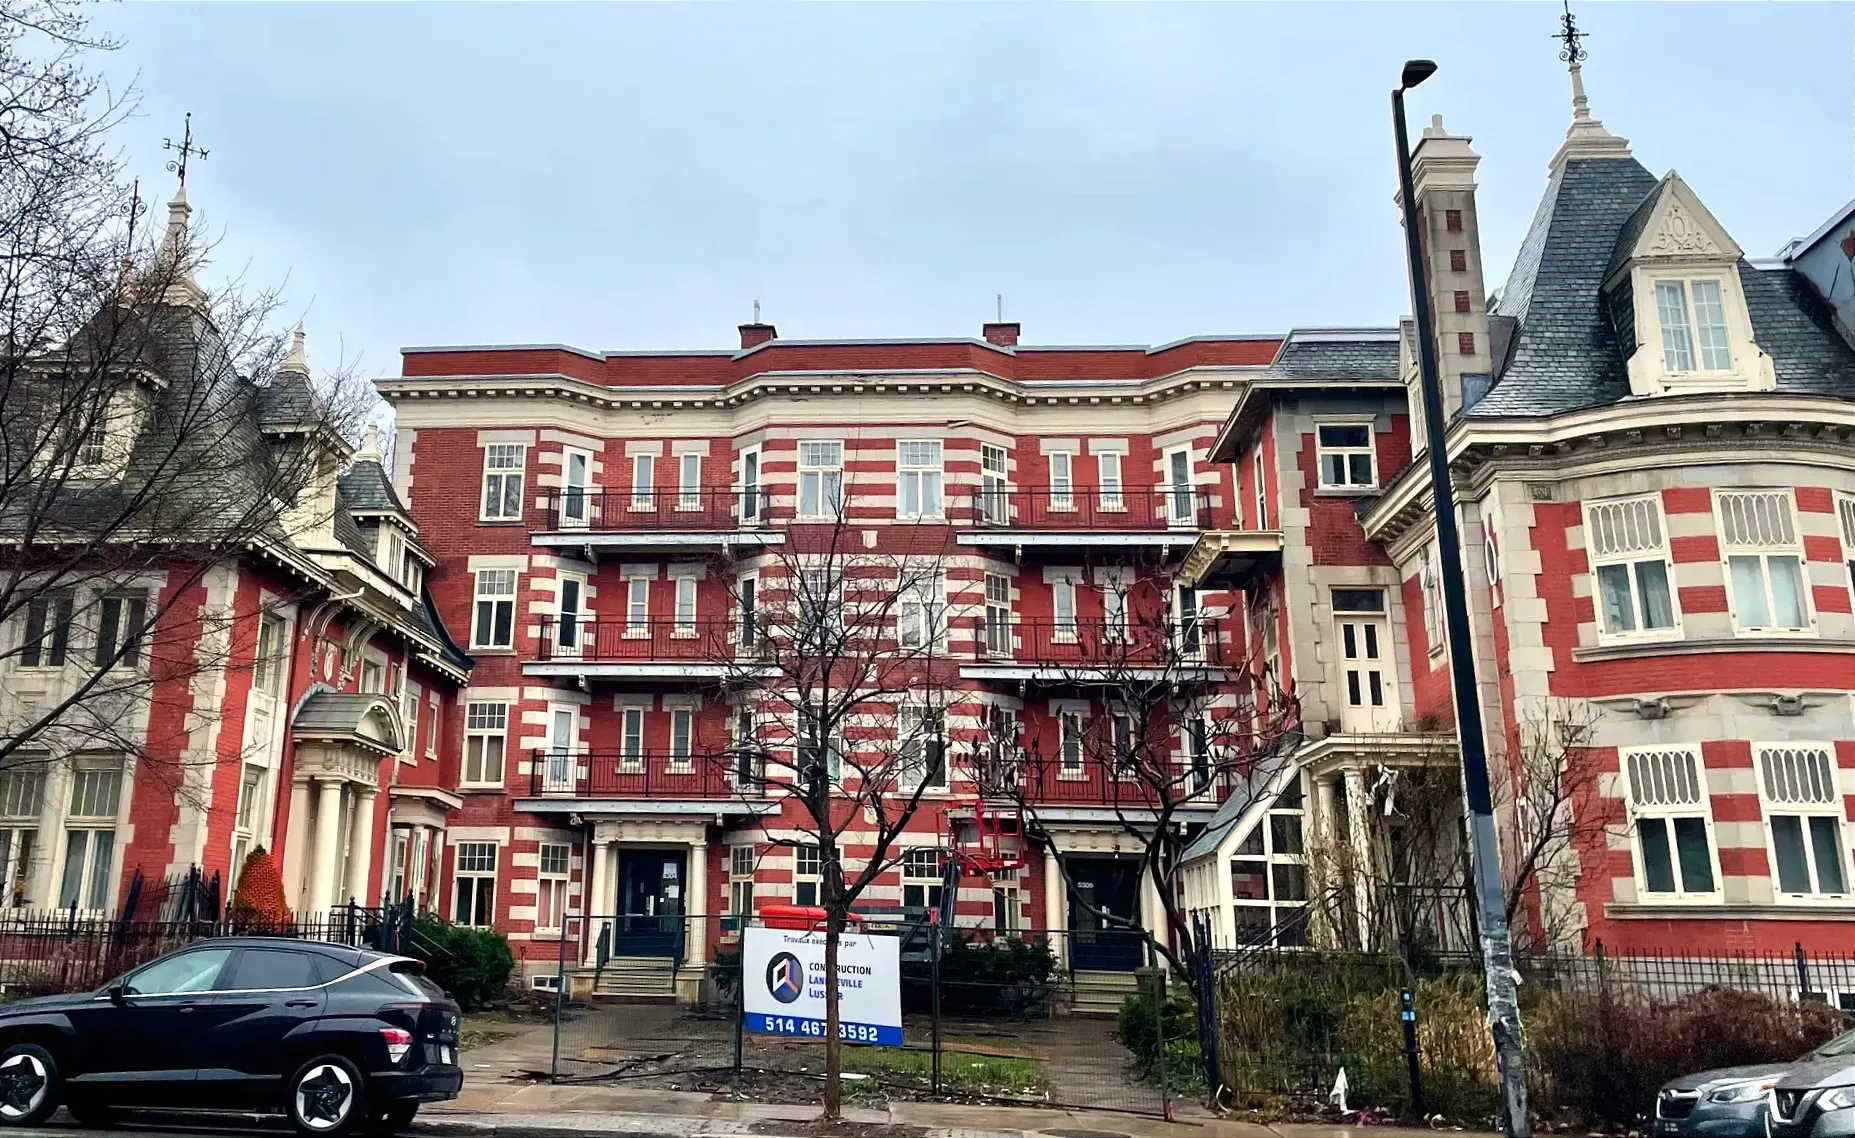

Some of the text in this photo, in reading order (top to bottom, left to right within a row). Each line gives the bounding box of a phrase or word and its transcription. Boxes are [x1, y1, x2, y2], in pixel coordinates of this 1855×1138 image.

[783, 934, 857, 949] Travaux exécs par
[809, 962, 872, 976] CONRUCTION
[808, 974, 863, 989] LANEVILLE
[808, 988, 844, 1001] LUSR
[765, 1016, 878, 1042] 514 467 3592
